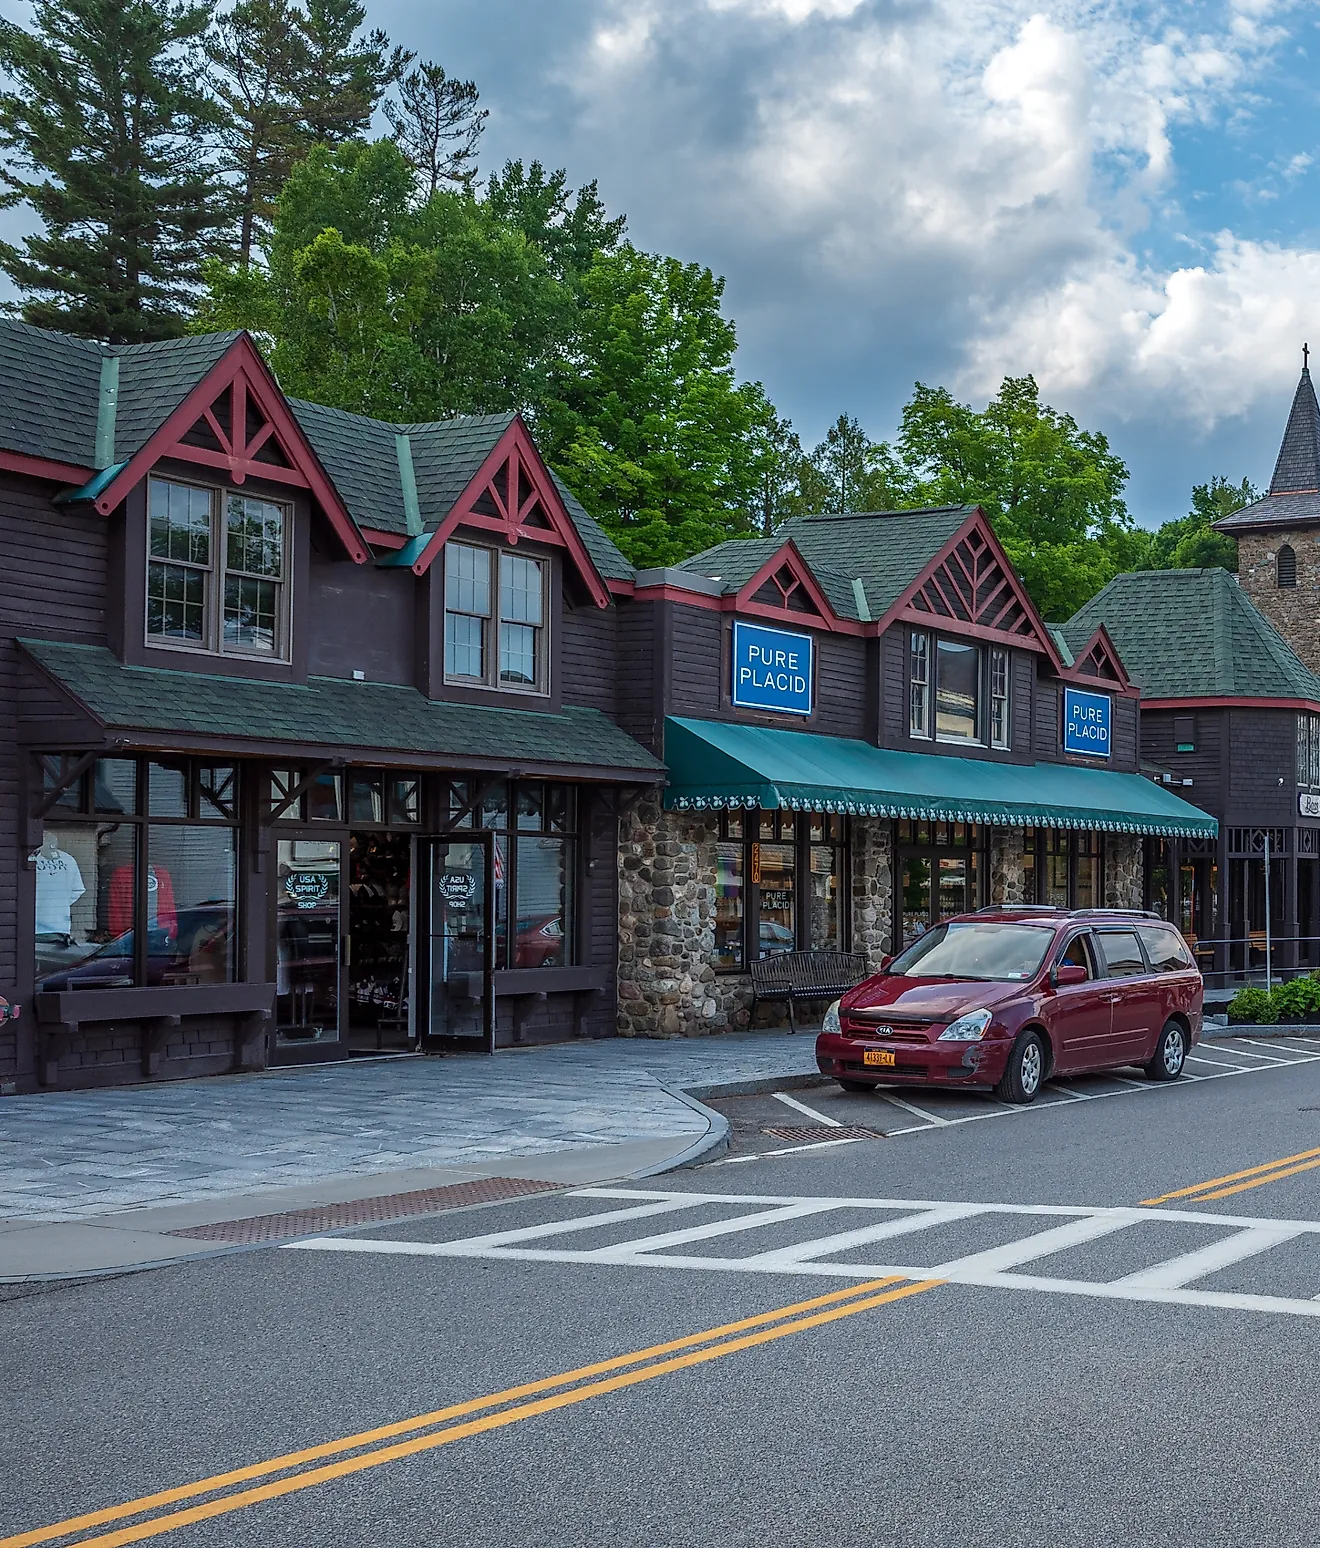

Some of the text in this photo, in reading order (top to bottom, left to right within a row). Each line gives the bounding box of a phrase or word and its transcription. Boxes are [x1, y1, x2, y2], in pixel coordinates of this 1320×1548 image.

[749, 645, 799, 670] PURE
[740, 667, 806, 693] PLACID
[1073, 705, 1103, 723] PURE
[1068, 722, 1108, 741] PLACID
[299, 876, 317, 884] USA
[295, 885, 321, 893] SPIRIT
[766, 892, 787, 900] PURE
[762, 901, 790, 910] PLACID
